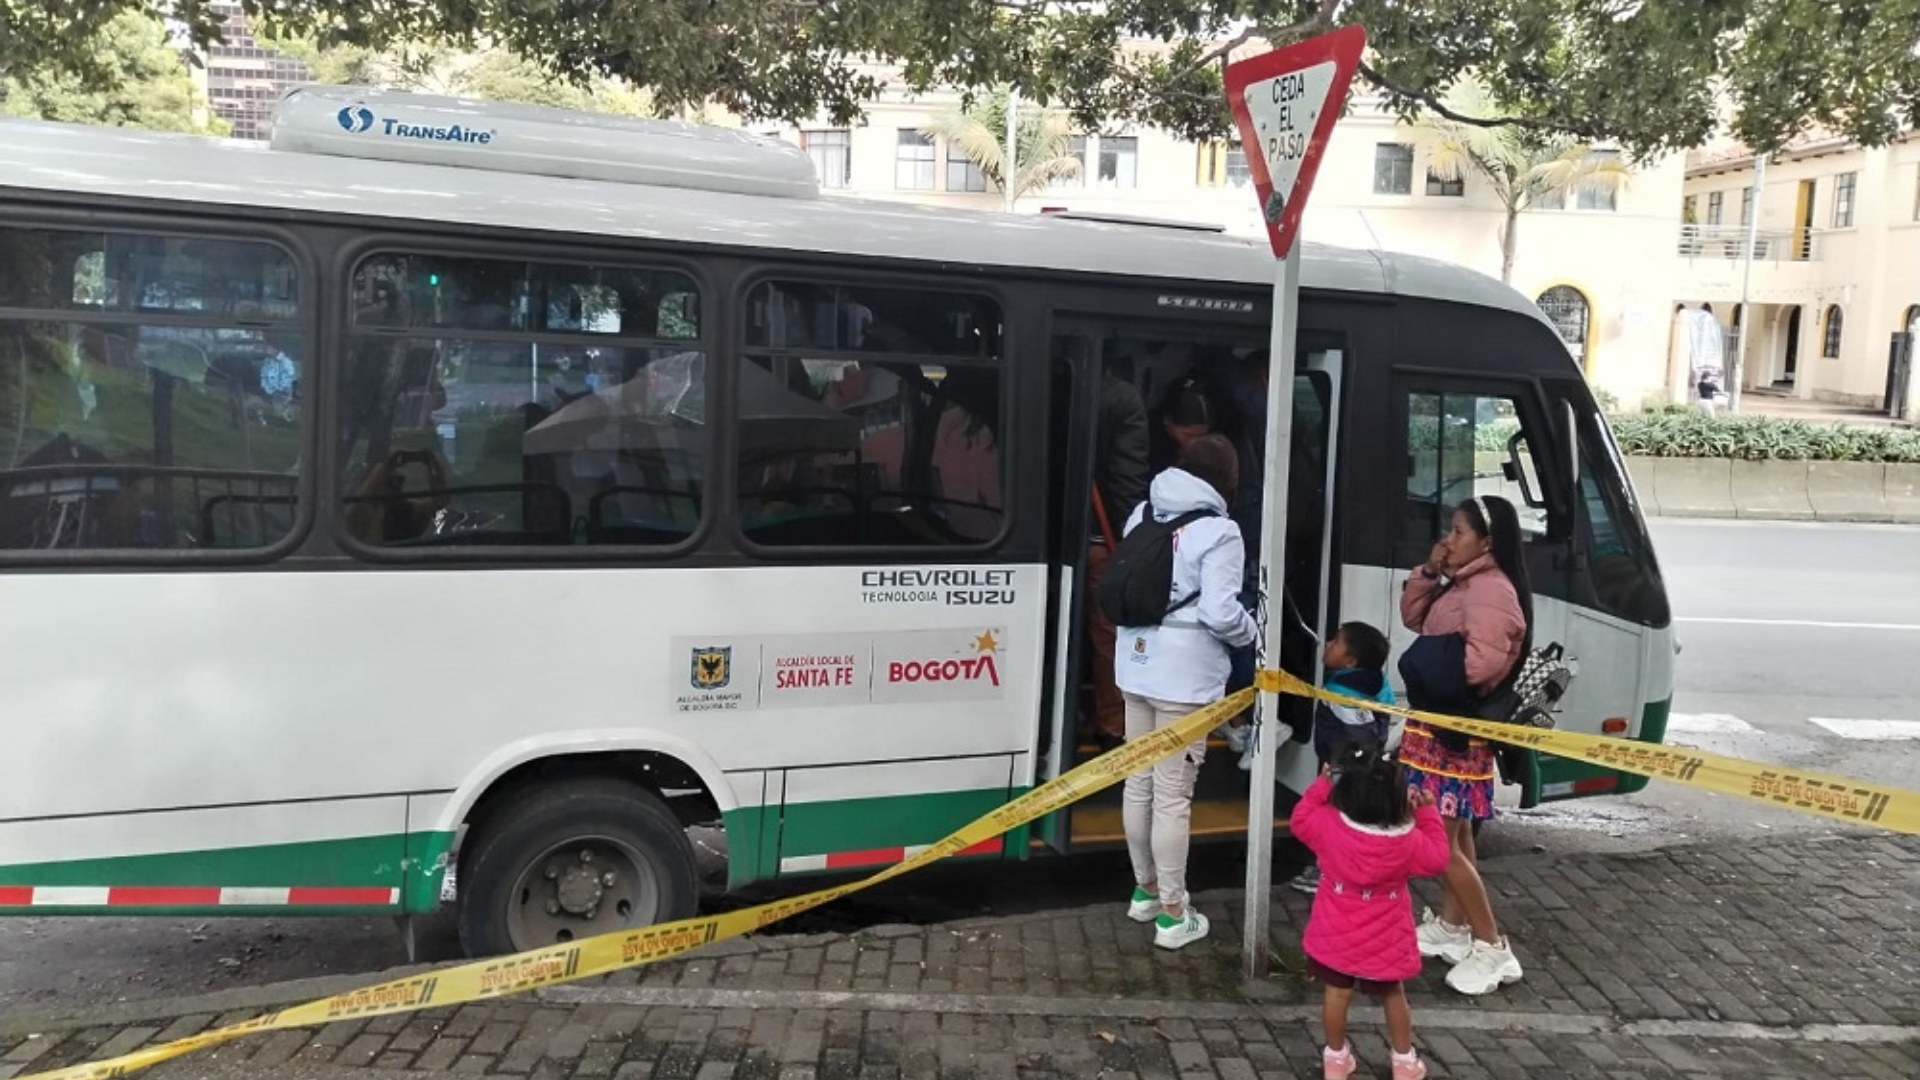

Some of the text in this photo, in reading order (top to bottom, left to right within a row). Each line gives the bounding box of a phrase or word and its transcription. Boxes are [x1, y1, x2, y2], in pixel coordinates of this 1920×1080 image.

[1272, 73, 1305, 104] CEDA
[1279, 107, 1294, 132] EL
[1268, 133, 1304, 163] PASO
[1163, 296, 1249, 311] SENIOR
[861, 570, 1016, 586] CHEVROLET
[862, 590, 1015, 605] TECNOLOGIA ISUZU
[817, 656, 842, 665] LOCAL
[844, 655, 855, 665] DE
[776, 667, 853, 688] SANTA FE
[1751, 776, 1857, 810] PELIGRO NO PASE
[622, 931, 700, 957] PELIGRO NO PASE
